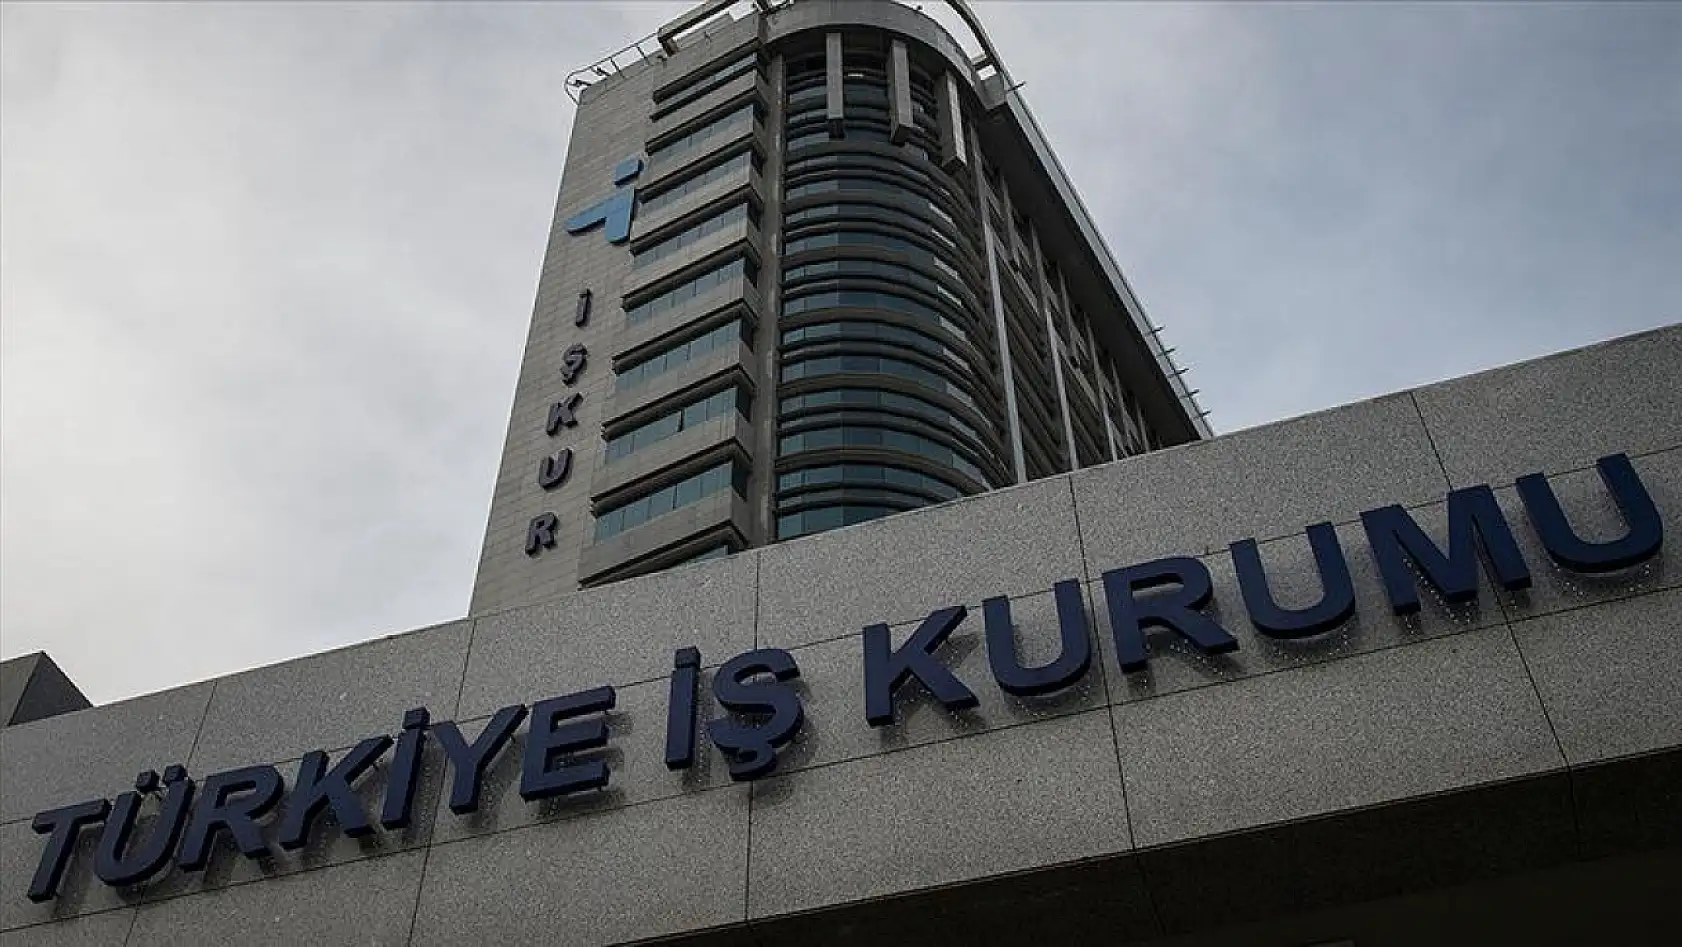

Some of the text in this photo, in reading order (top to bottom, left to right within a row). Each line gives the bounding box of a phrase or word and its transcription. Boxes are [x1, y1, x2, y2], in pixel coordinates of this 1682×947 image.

[525, 288, 592, 555] İŞKUR
[27, 453, 1664, 903] TÜRKİYE İŞ KURUMU
